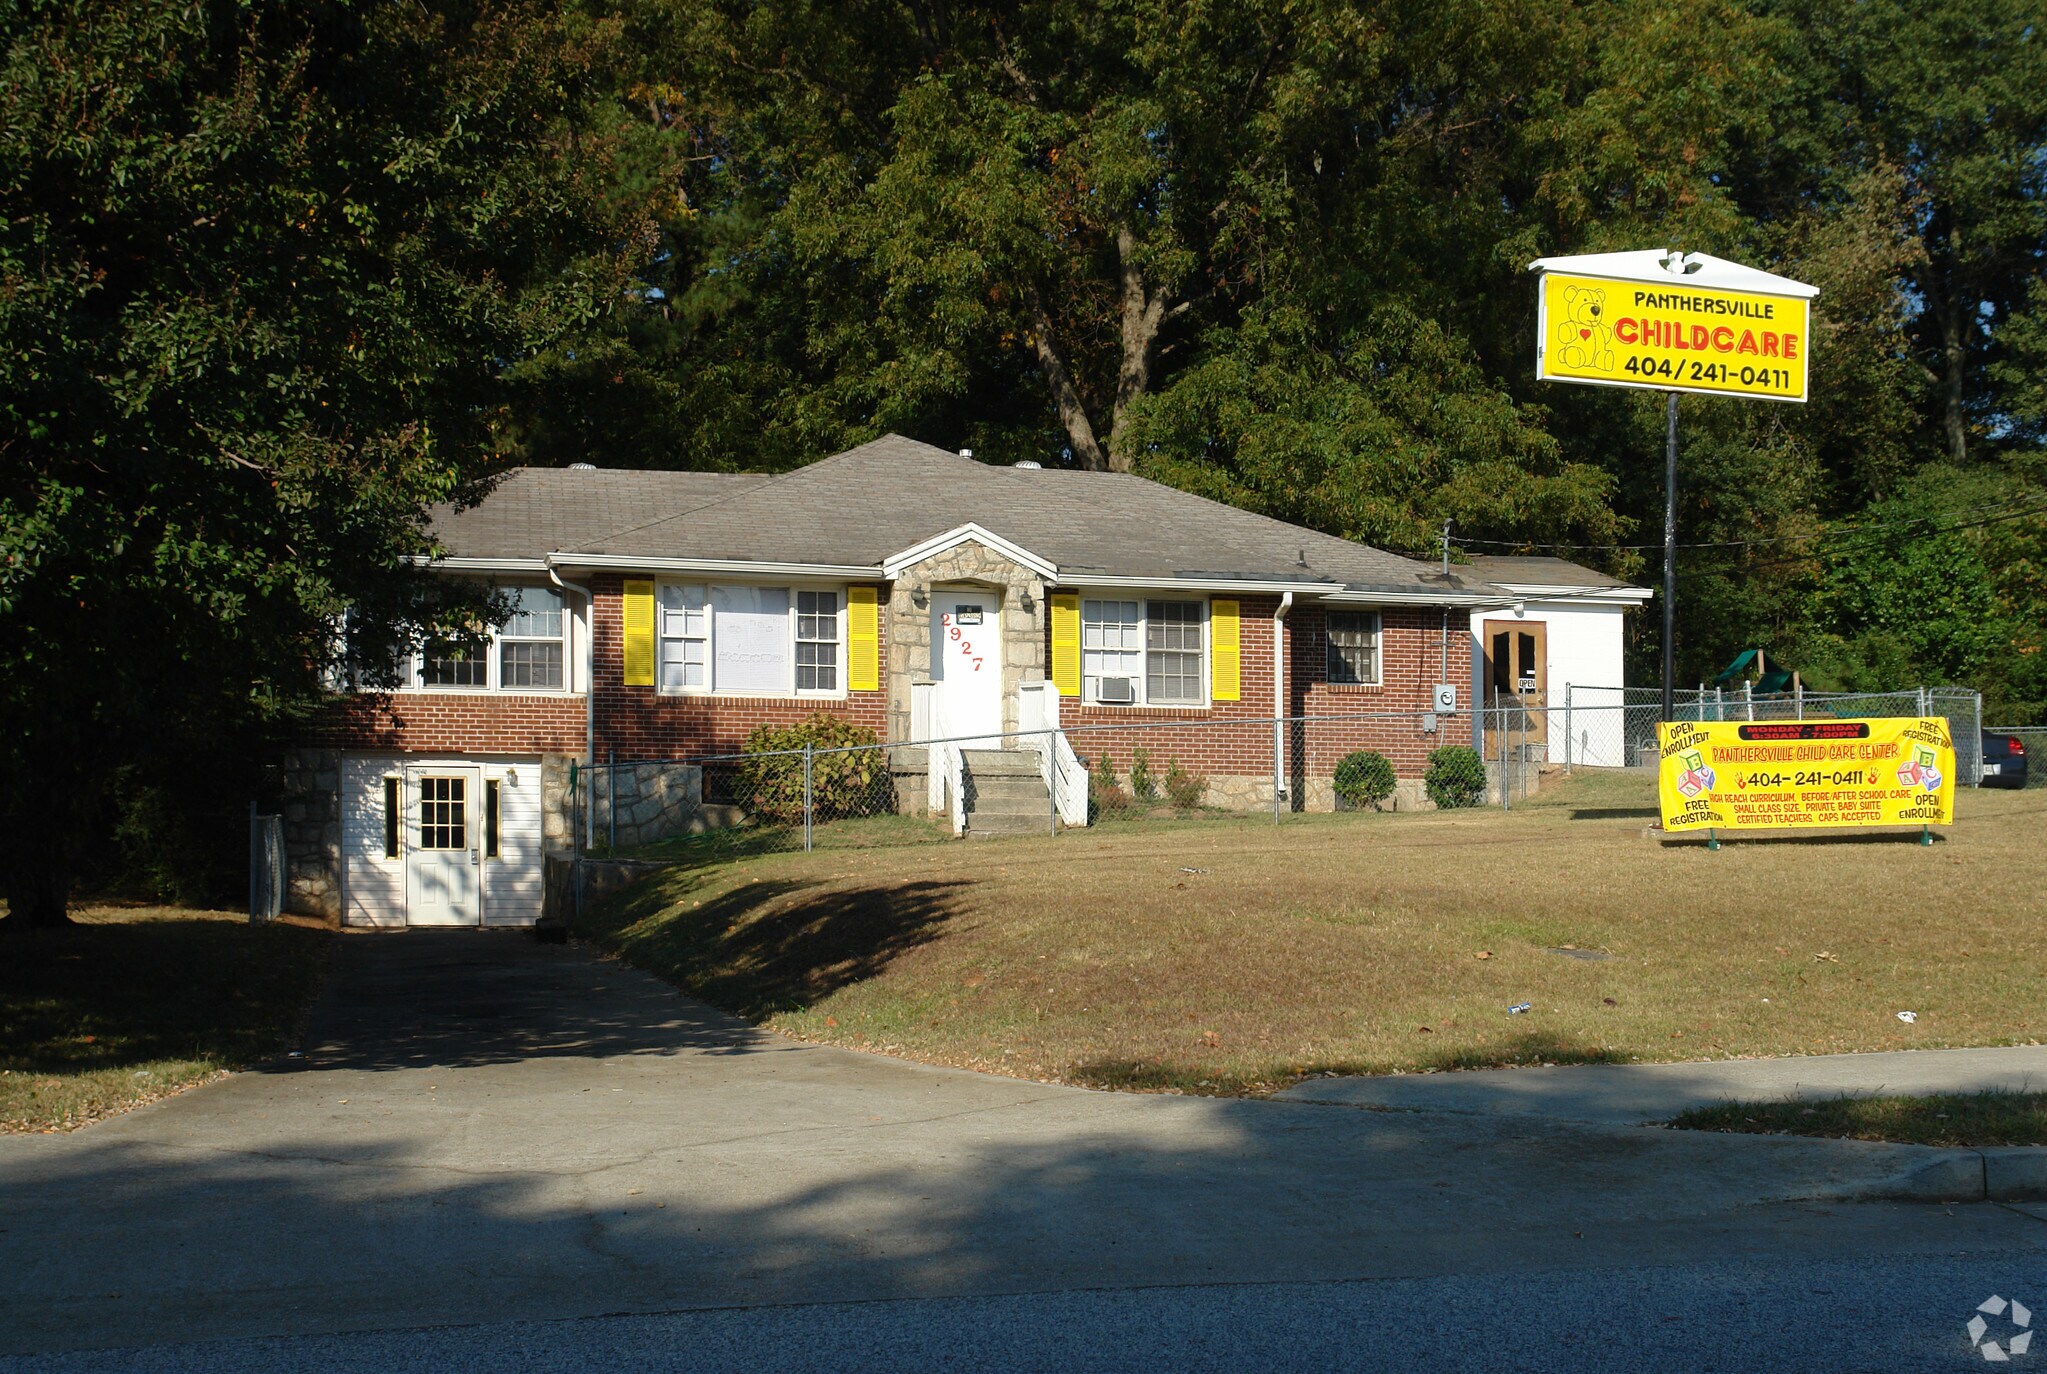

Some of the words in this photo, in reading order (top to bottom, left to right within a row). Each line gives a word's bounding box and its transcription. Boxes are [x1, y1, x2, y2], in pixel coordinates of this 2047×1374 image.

[1634, 291, 1774, 320] PANTHERSVILLE
[1613, 317, 1799, 360] CHILDCARE
[1670, 722, 1694, 739] OPEN
[1920, 721, 1939, 734] FREE
[1661, 732, 1710, 759] ENROLLMENT
[1712, 746, 1793, 762] PANTHERSVILLE
[1796, 746, 1827, 761] CHILD
[1829, 744, 1856, 760] CARE
[1859, 744, 1899, 759] CENTER
[1725, 793, 1748, 803] REACH
[1801, 790, 1857, 802] BEFORE/AFTER
[1859, 790, 1887, 800] SCHOOL
[1890, 789, 1911, 799] CARE
[1915, 794, 1940, 806] OPEN
[1685, 800, 1710, 811] FREE
[1734, 804, 1757, 813] SMALL
[1758, 804, 1782, 813] CLASS
[1806, 802, 1835, 812] PRIVATE
[1838, 801, 1858, 811] BABY
[1859, 801, 1881, 810] SUITE
[1670, 812, 1723, 825] REGISTRATION
[1737, 814, 1773, 824] CERTIFIED
[1818, 812, 1840, 822] CAPS
[1841, 811, 1881, 821] ACCEPTED
